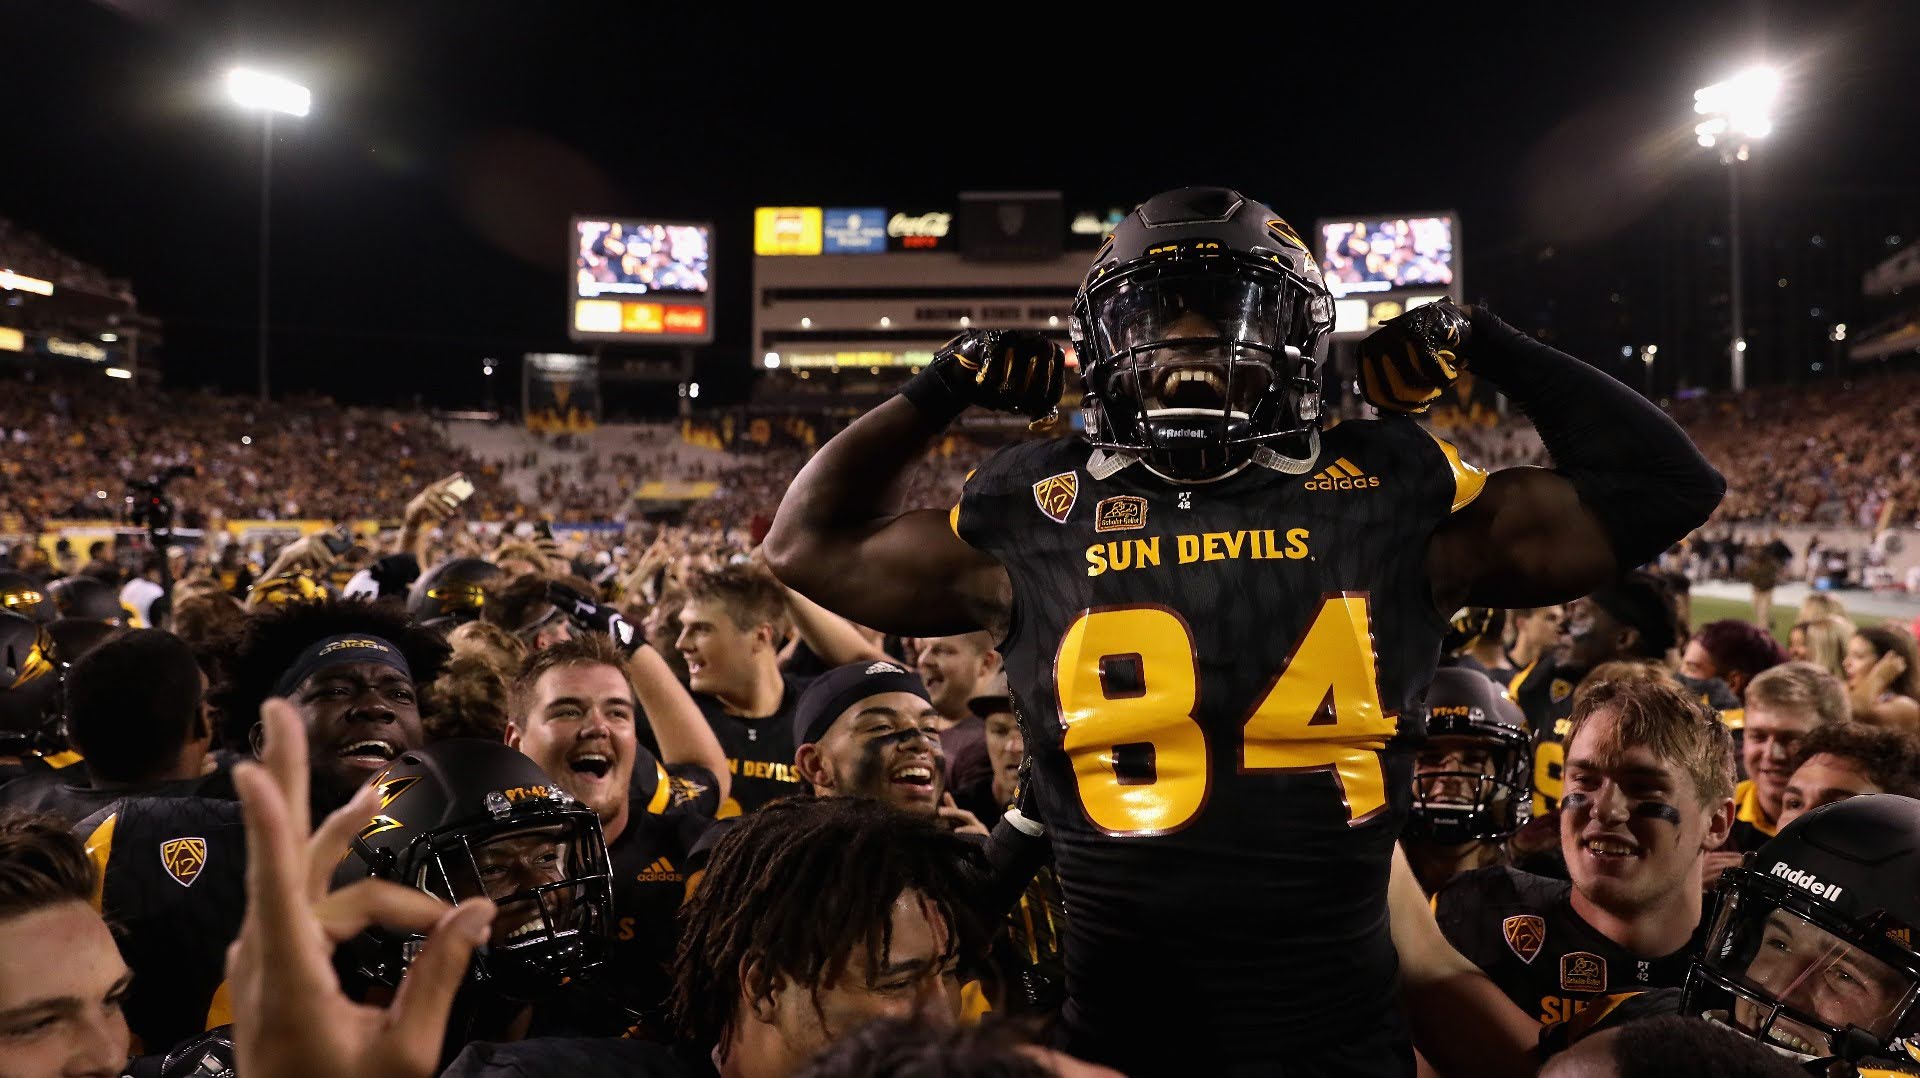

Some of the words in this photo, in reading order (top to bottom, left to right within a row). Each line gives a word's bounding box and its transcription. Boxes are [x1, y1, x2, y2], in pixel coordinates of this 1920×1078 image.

[1036, 474, 1076, 510] PAC
[1304, 476, 1380, 491] adidas
[1048, 493, 1070, 516] 12
[1178, 491, 1192, 500] PT
[1177, 501, 1191, 510] 42
[1085, 536, 1161, 577] SUN
[1176, 527, 1310, 565] DEVILS
[319, 641, 389, 656] adidas
[1052, 590, 1400, 837] 84
[163, 839, 204, 870] PAC
[175, 857, 197, 877] 12
[636, 872, 683, 882] adidas
[1770, 861, 1843, 902] Riddell
[1505, 917, 1543, 943] PAC
[1516, 934, 1537, 951] 12
[1637, 960, 1650, 970] PT
[1636, 972, 1649, 982] 42
